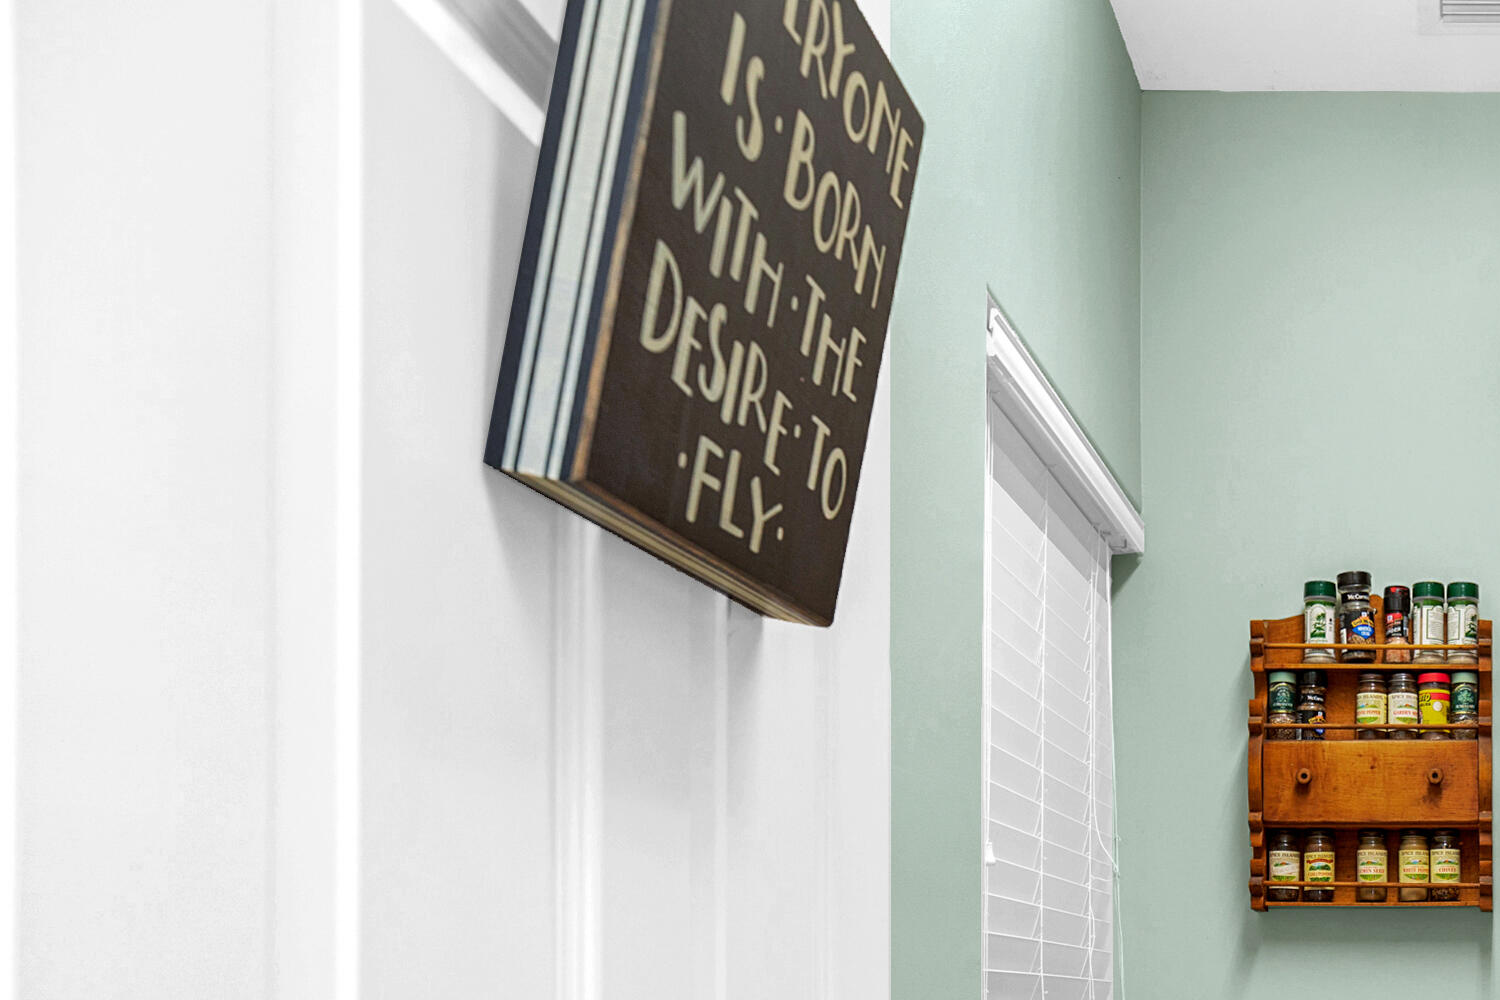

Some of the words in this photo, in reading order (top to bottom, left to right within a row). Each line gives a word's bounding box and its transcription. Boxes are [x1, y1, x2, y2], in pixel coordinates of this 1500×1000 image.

[672, 110, 784, 328] WITH
[800, 275, 866, 402] THE
[784, 109, 886, 309] BORN
[640, 239, 794, 475] DESIRE
[807, 415, 848, 520] TO
